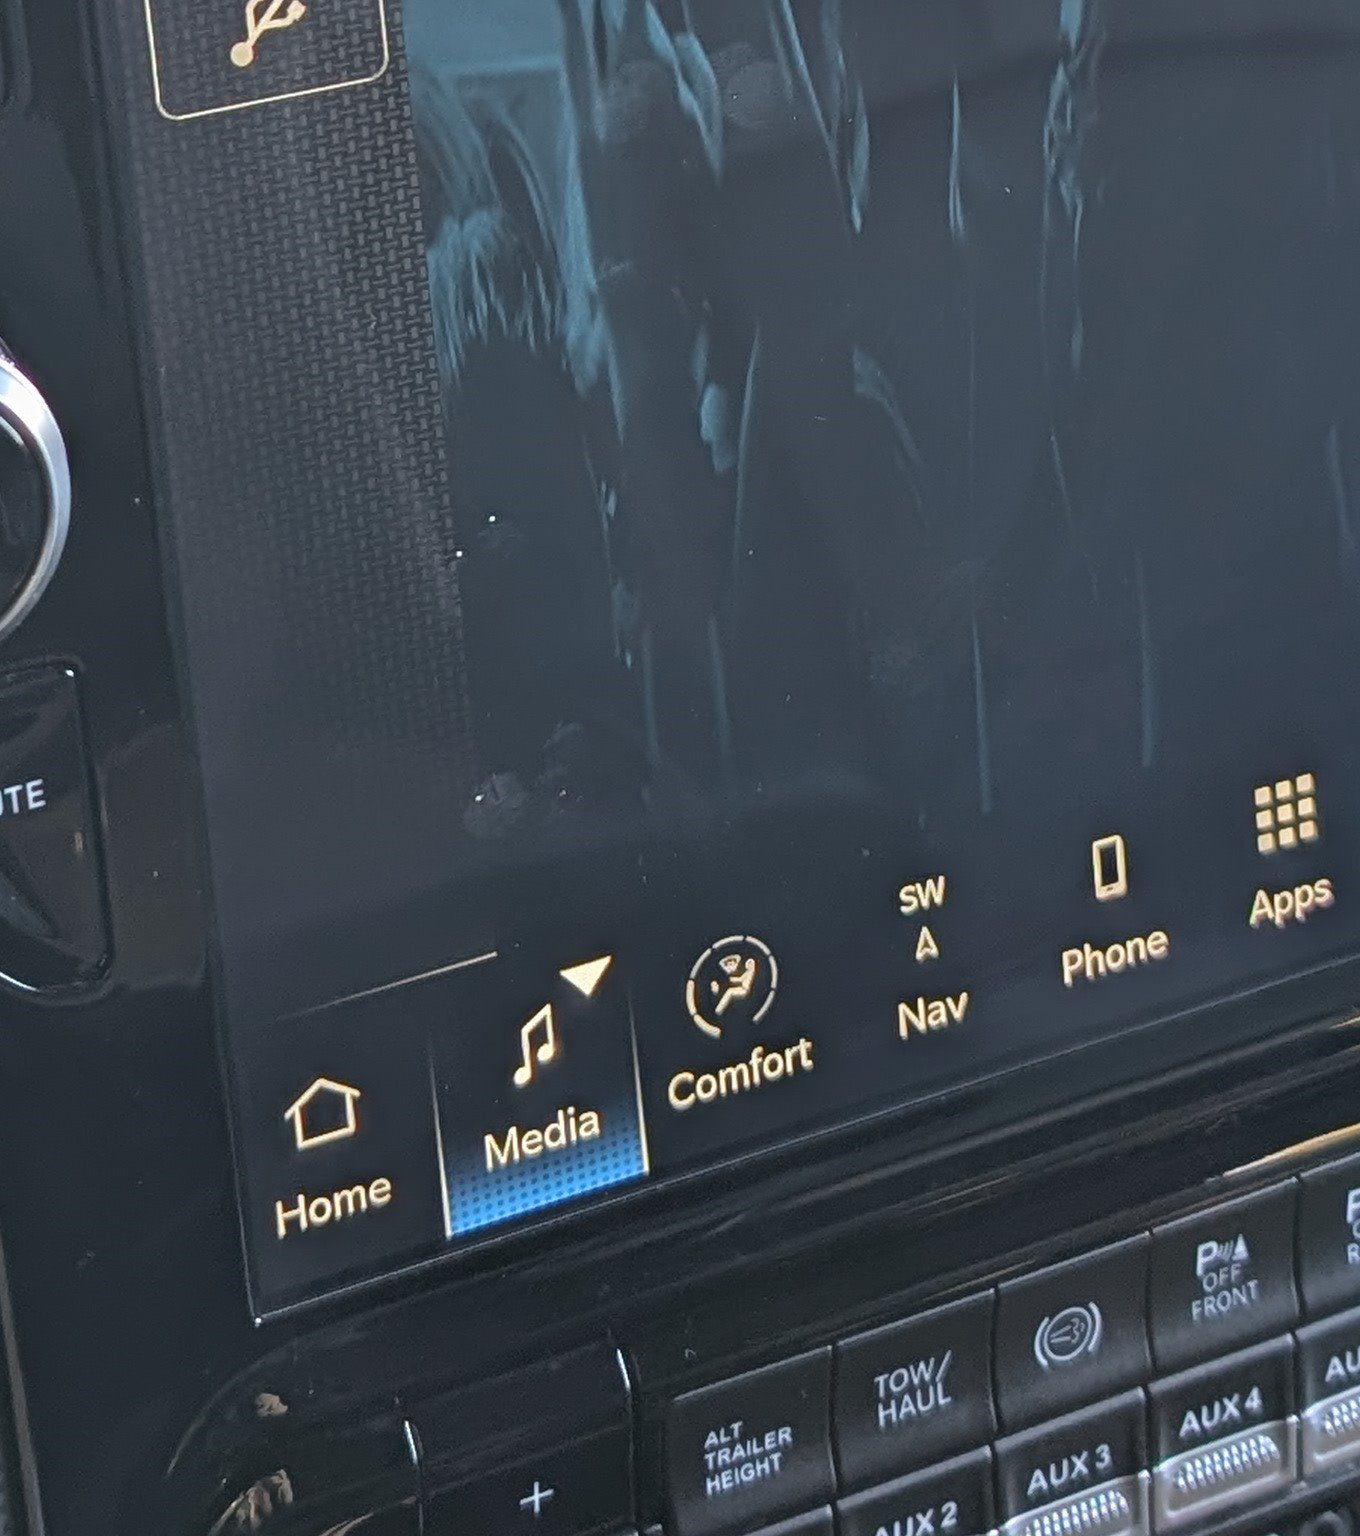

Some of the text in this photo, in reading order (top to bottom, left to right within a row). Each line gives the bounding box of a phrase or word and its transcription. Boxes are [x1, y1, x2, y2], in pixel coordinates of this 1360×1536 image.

[899, 875, 946, 916] SW
[1249, 876, 1335, 929] Apps
[1062, 928, 1169, 988] Phone
[897, 990, 970, 1040] Nav
[667, 1036, 815, 1113] Comfort
[484, 1106, 602, 1172] Media
[274, 1175, 393, 1241] Home
[1191, 1279, 1259, 1324] FRONT
[1202, 1266, 1242, 1294] OFF
[878, 1381, 951, 1430] HAUL
[1178, 1386, 1263, 1440] AUX 4
[703, 1420, 743, 1451] ALT
[704, 1425, 794, 1471] TRAILER
[705, 1452, 783, 1497] HEIGHT
[1026, 1443, 1112, 1497] AUX 3
[940, 1500, 958, 1529] 2
